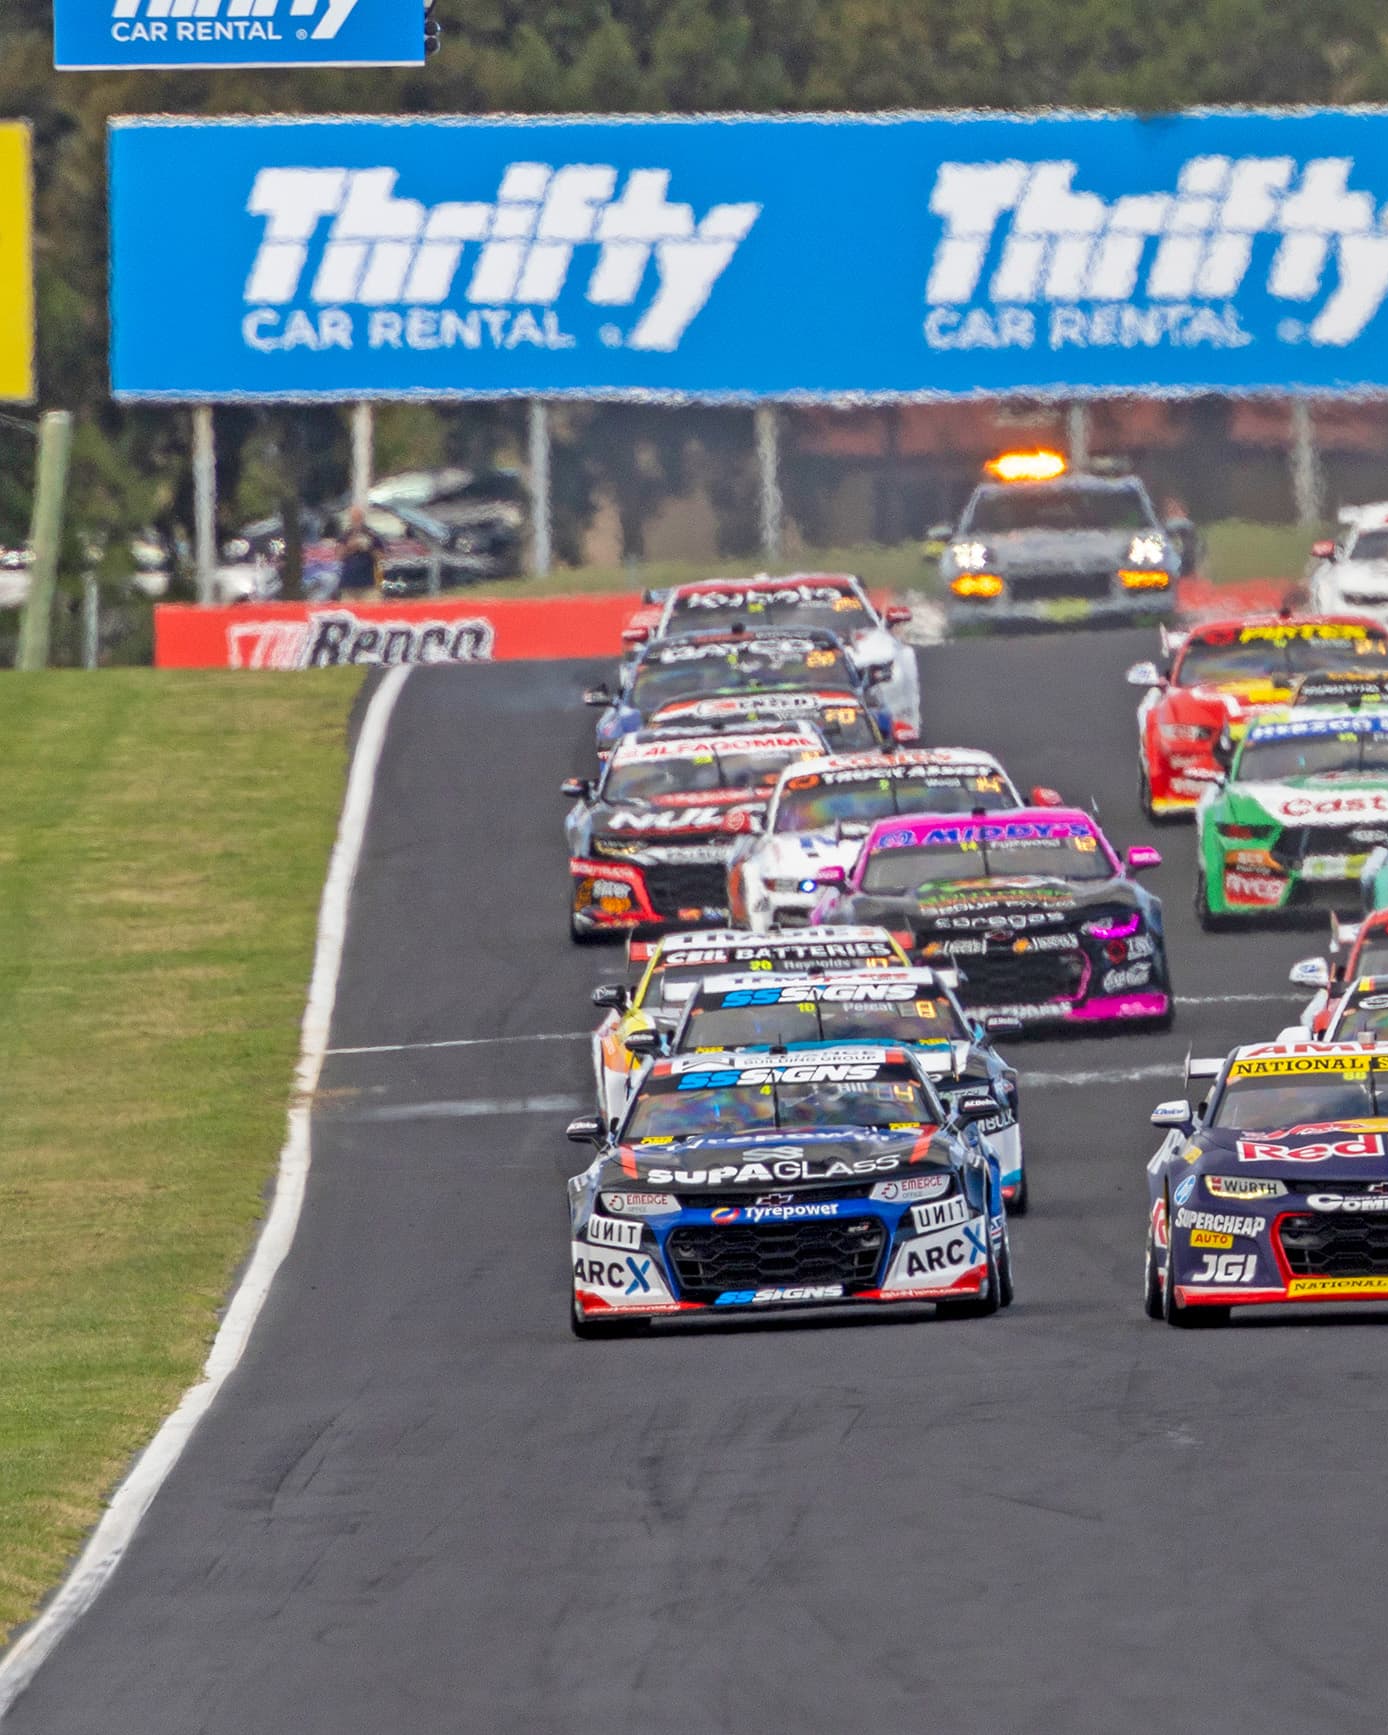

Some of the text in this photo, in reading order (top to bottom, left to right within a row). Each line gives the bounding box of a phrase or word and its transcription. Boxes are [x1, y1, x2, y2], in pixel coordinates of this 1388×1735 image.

[111, 21, 283, 42] CAR RENTAL
[244, 163, 763, 351] Thrifty
[243, 308, 576, 350] CAR RENTAL
[924, 305, 1253, 350] CAR RENTAL
[923, 822, 1093, 845] MIDDY'S
[735, 941, 892, 961] BATTERIES
[1237, 1058, 1365, 1075] NATIONAL
[1236, 1134, 1384, 1162] Red
[902, 1175, 944, 1191] EMERGE
[1224, 1179, 1278, 1195] WÜRTH
[626, 1194, 668, 1206] EMERGE
[745, 1201, 839, 1222] Tyrepower
[918, 1200, 966, 1228] UNIT
[590, 1218, 637, 1245] UNIT
[1175, 1208, 1266, 1238] SUPERCHEAP
[1194, 1233, 1228, 1244] AUTO
[1191, 1254, 1258, 1282] JGI
[1294, 1279, 1388, 1291] NATIONAL
